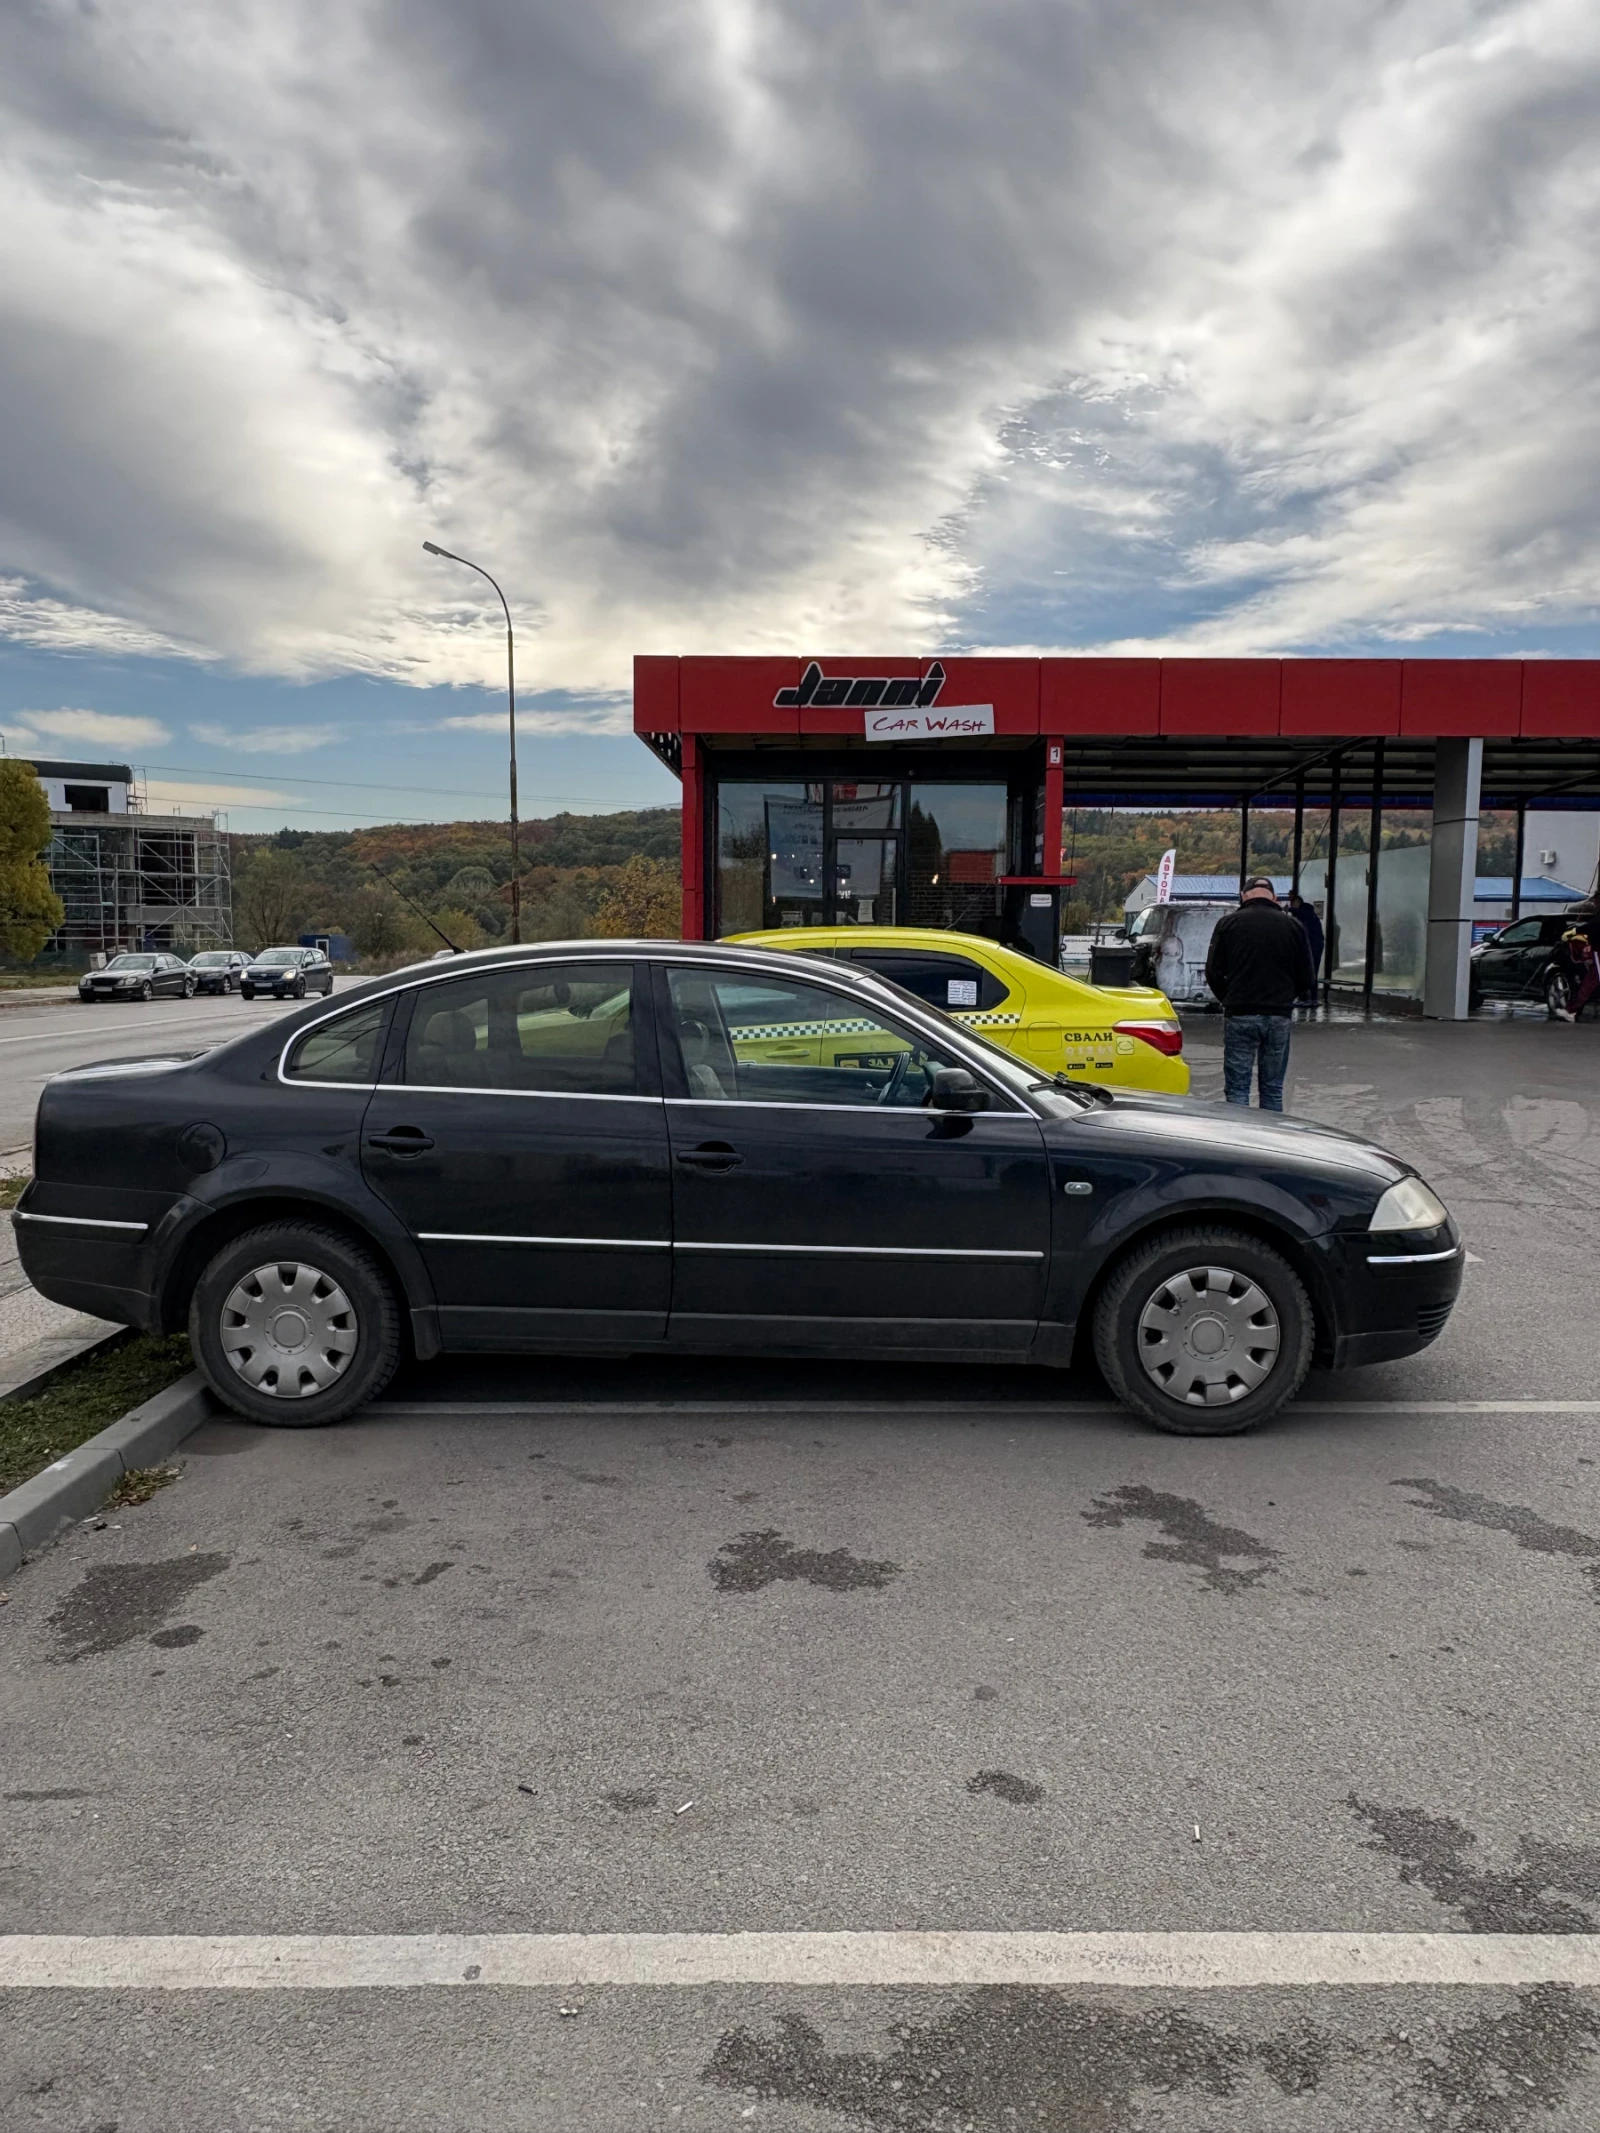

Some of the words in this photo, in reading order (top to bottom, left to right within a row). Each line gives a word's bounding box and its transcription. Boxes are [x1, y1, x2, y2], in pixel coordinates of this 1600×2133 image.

[772, 660, 947, 709] Janni
[872, 716, 919, 732] CAR
[925, 716, 987, 732] WASH
[1052, 748, 1059, 759] 1
